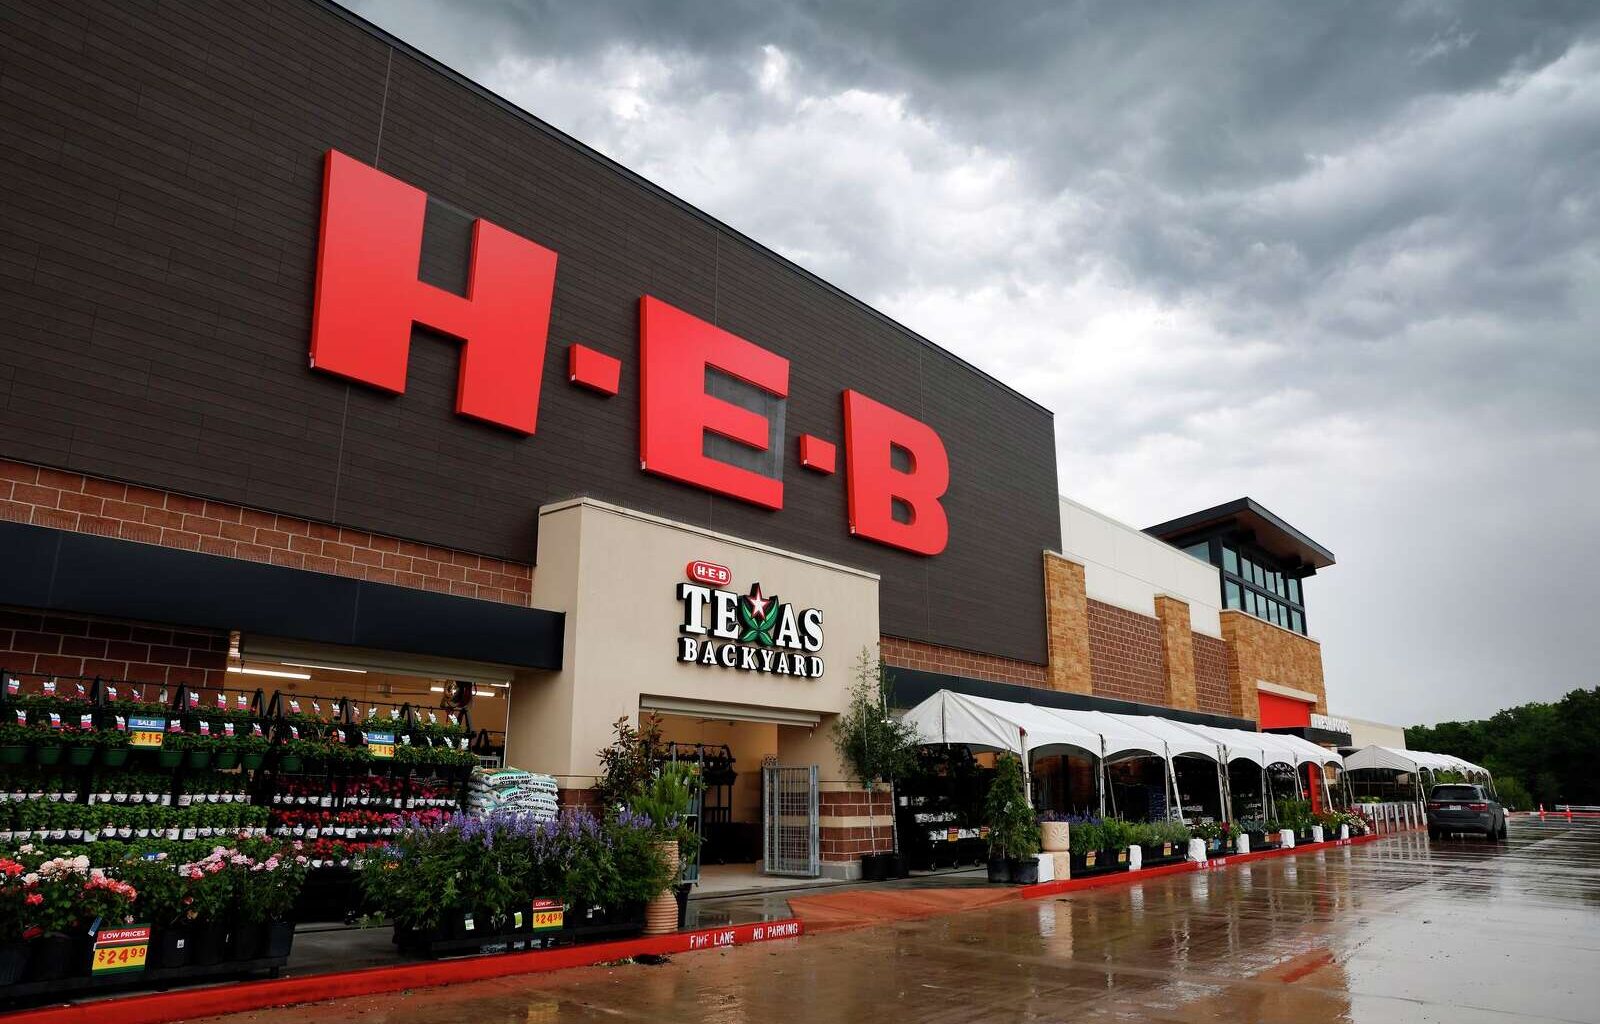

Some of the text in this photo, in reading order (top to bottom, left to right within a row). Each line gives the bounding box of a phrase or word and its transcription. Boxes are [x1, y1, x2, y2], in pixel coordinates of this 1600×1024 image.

[678, 582, 825, 653] TEXAS
[678, 637, 825, 679] BACKYARD
[102, 930, 146, 940] LOW PRICES
[713, 931, 736, 945] LANE
[753, 927, 764, 940] NO
[767, 922, 798, 938] PARKING
